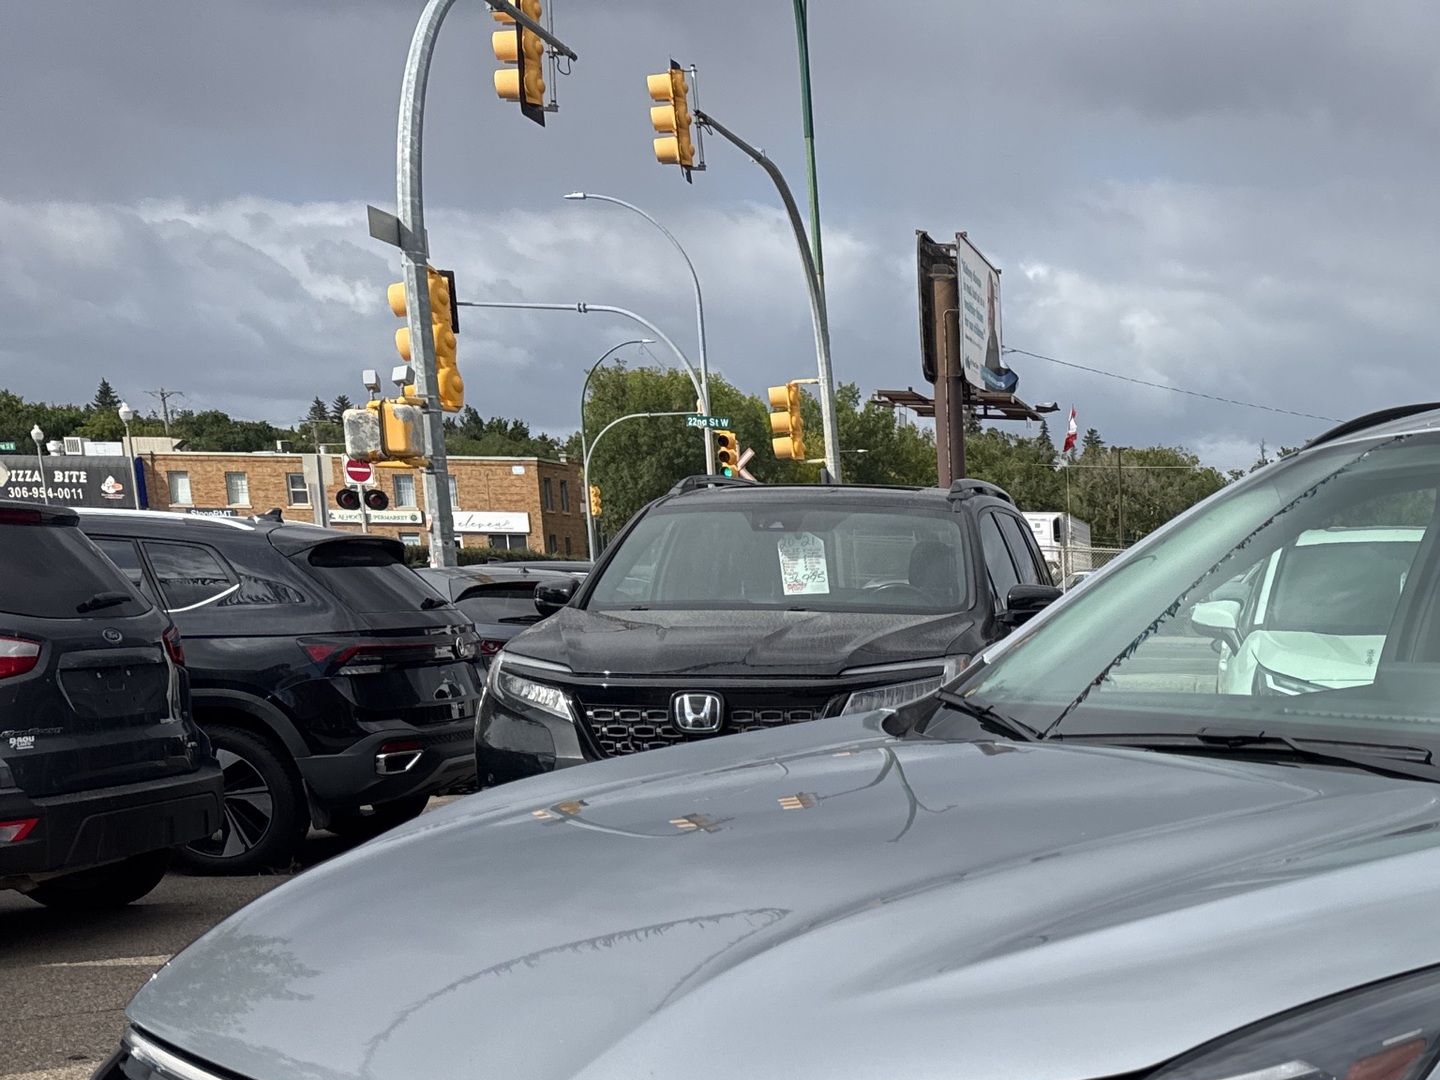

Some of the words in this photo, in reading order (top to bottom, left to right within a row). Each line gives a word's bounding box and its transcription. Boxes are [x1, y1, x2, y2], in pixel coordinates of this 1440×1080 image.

[709, 418, 719, 427] St
[720, 419, 729, 427] W
[53, 470, 88, 483] BITE
[7, 486, 84, 500] 306-954-0011
